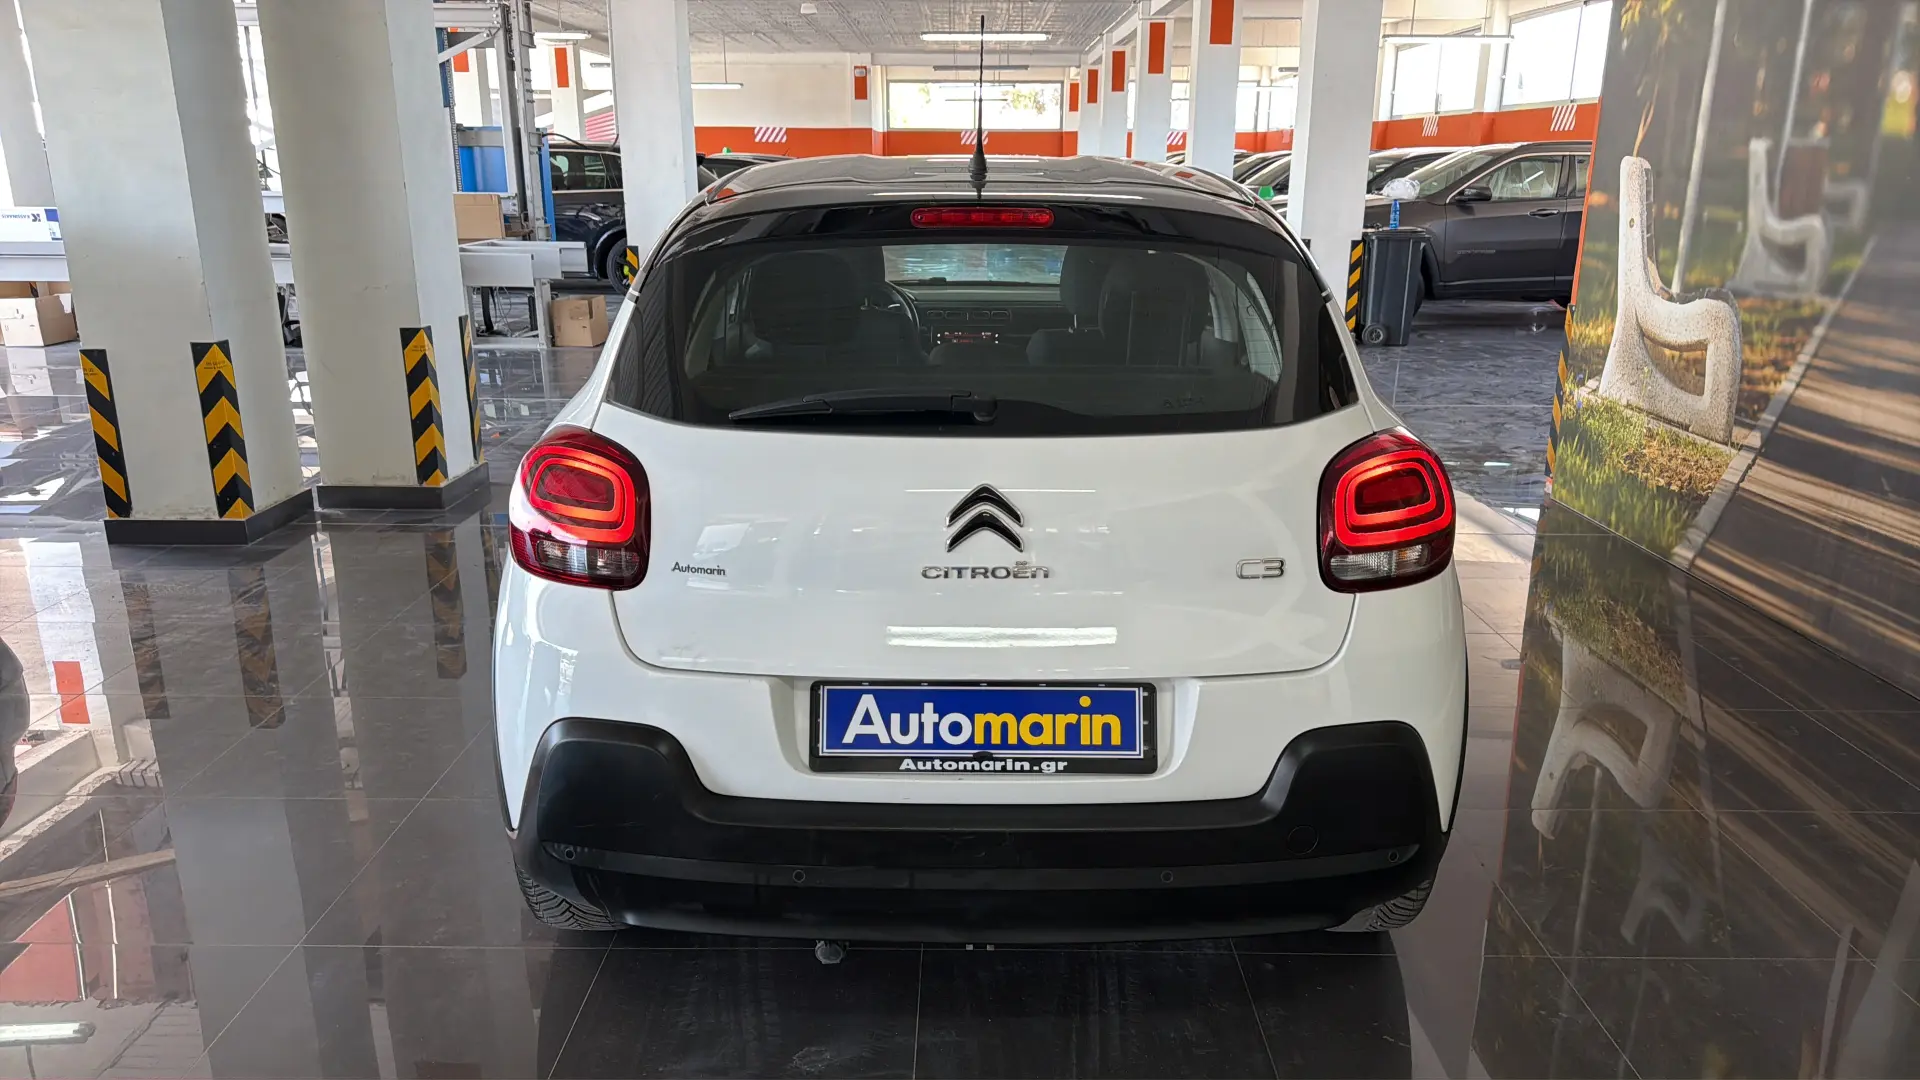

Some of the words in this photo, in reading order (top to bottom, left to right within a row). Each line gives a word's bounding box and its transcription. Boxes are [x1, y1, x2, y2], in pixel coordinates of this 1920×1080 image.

[671, 561, 726, 576] Automarin
[1236, 558, 1286, 579] C3
[842, 694, 1122, 746] Automarin
[899, 758, 1068, 774] Automarin.gr
